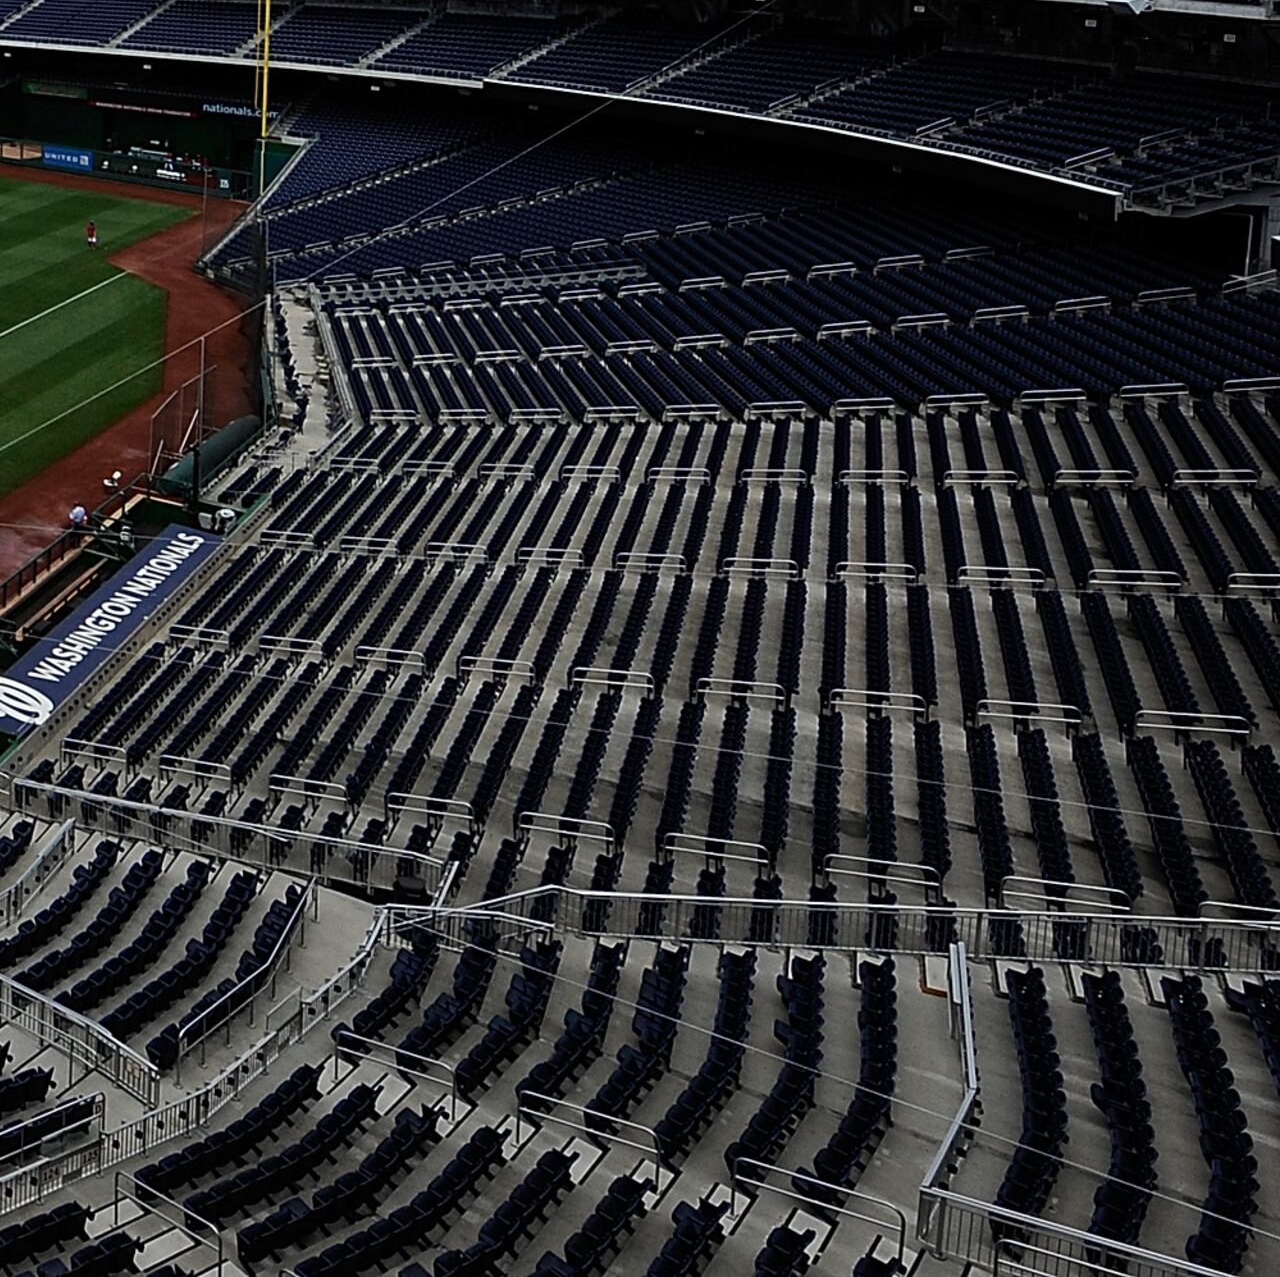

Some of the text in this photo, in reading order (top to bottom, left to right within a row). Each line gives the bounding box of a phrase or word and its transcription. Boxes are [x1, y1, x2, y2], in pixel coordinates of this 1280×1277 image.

[202, 103, 280, 119] nationals.cm
[43, 152, 79, 163] UNITED
[27, 532, 205, 683] WASHINGTON NATIONALS
